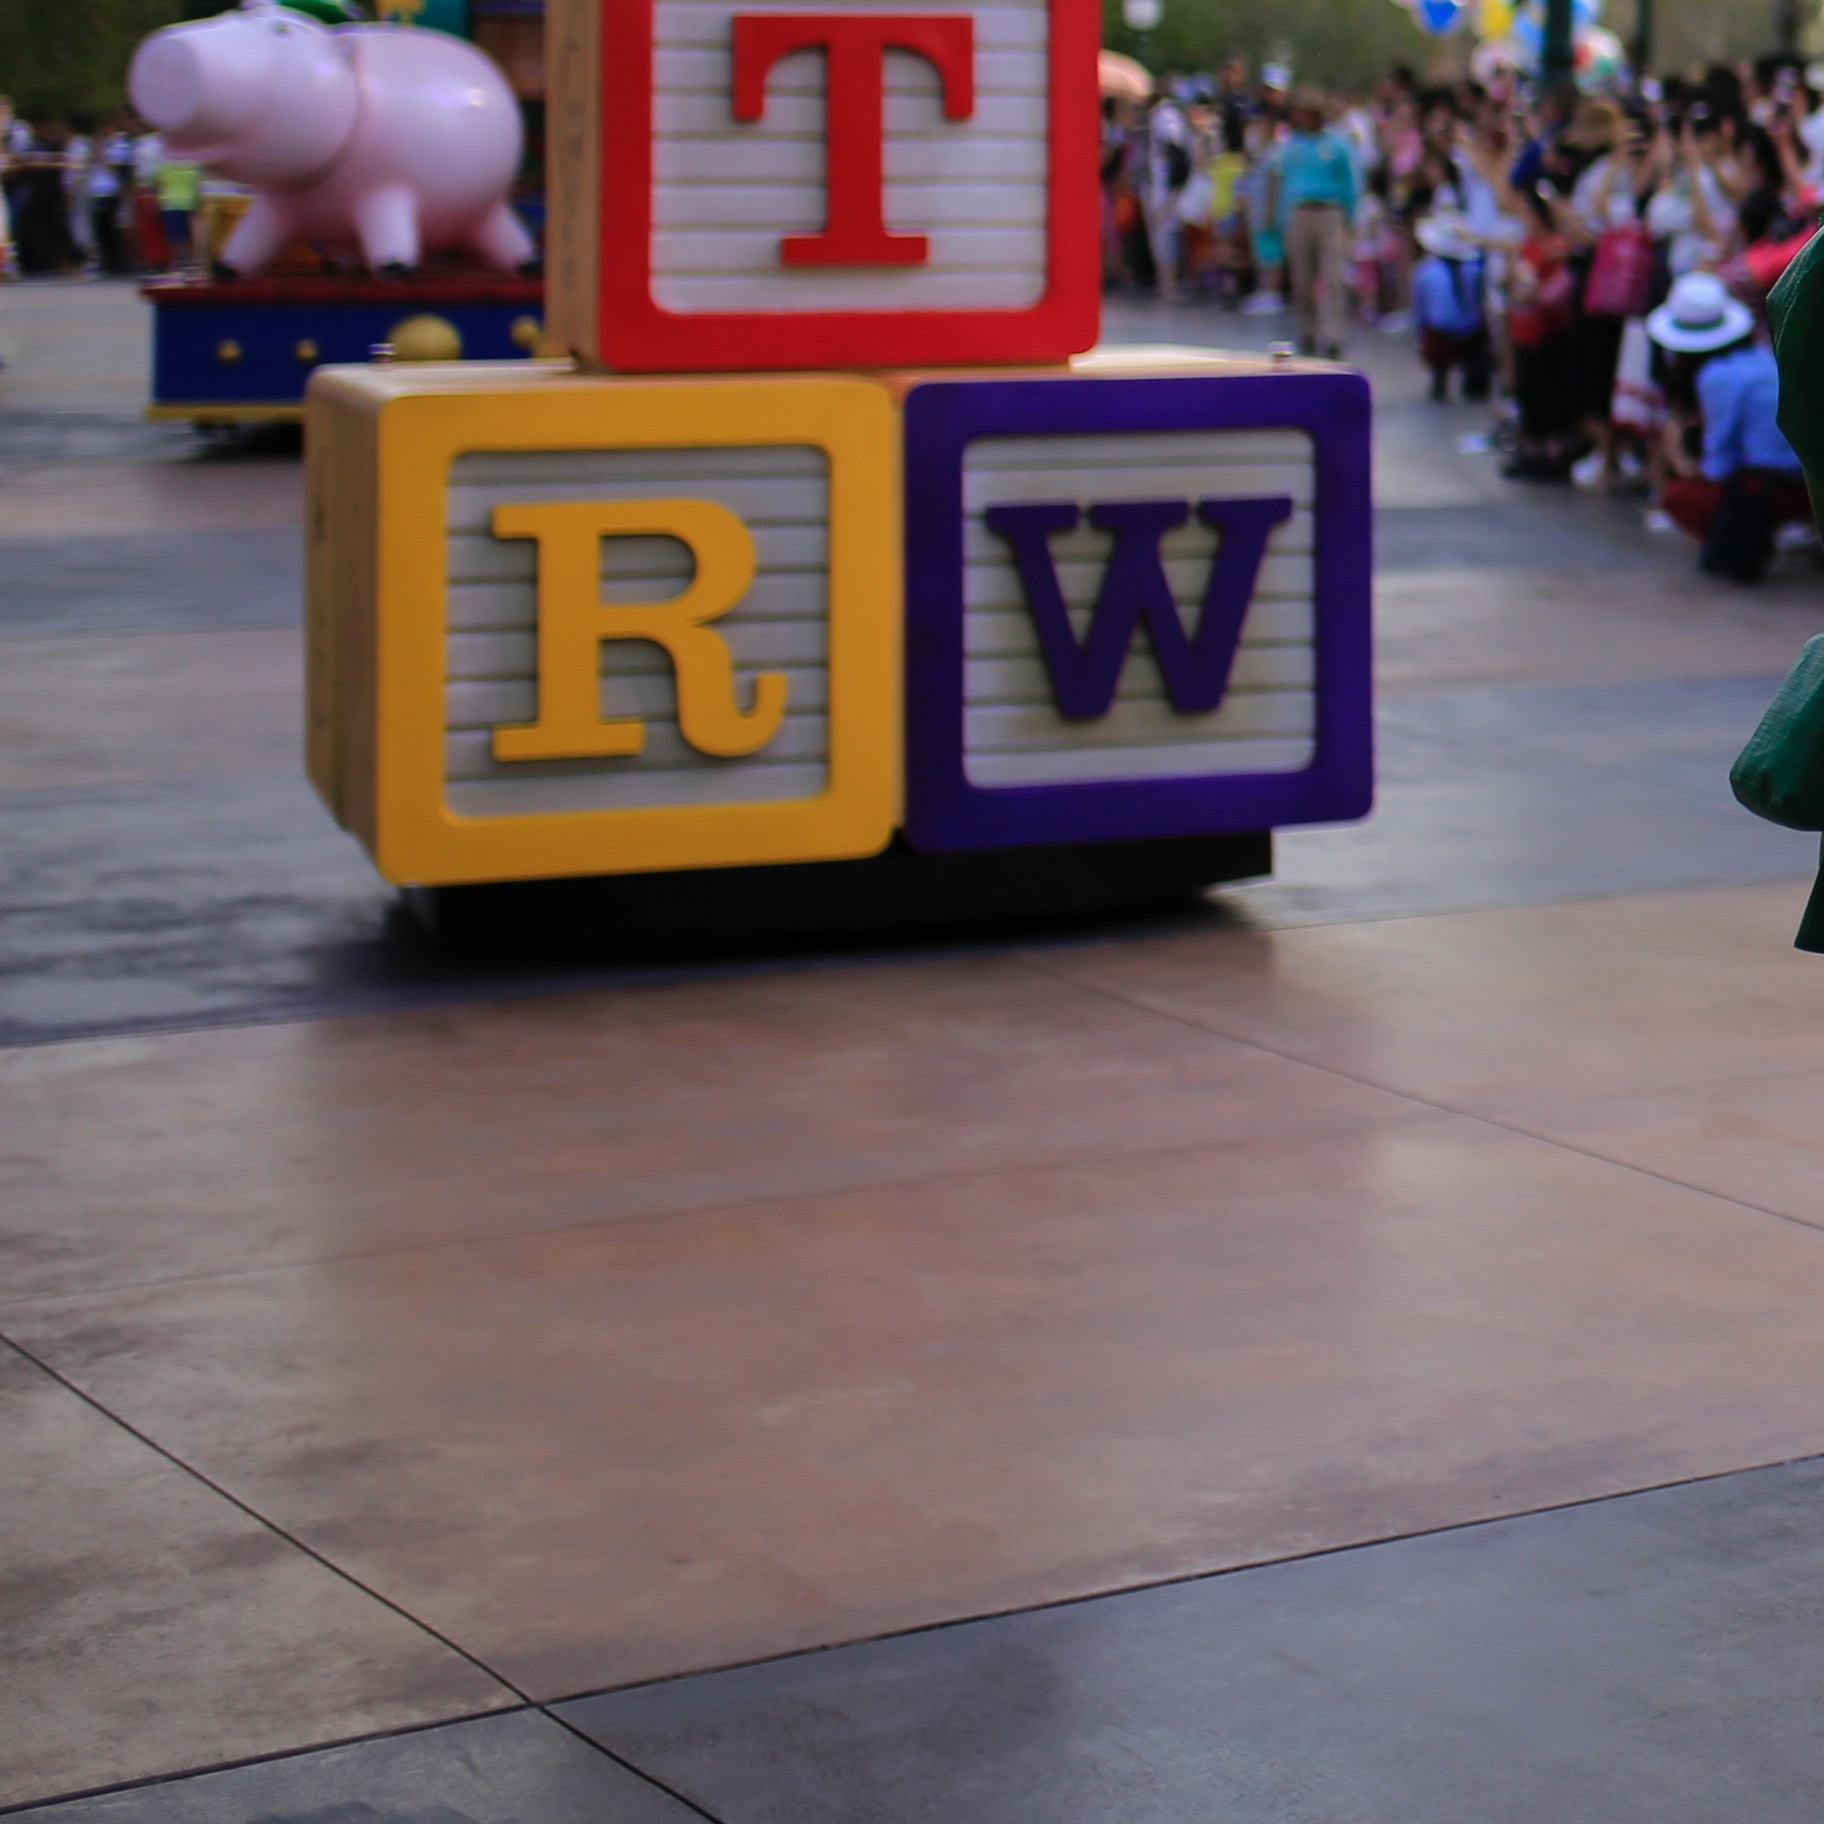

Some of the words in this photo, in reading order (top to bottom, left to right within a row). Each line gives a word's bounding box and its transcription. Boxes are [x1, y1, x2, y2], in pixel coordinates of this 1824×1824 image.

[734, 15, 974, 266] T
[491, 497, 788, 762] R
[986, 495, 1293, 723] W
